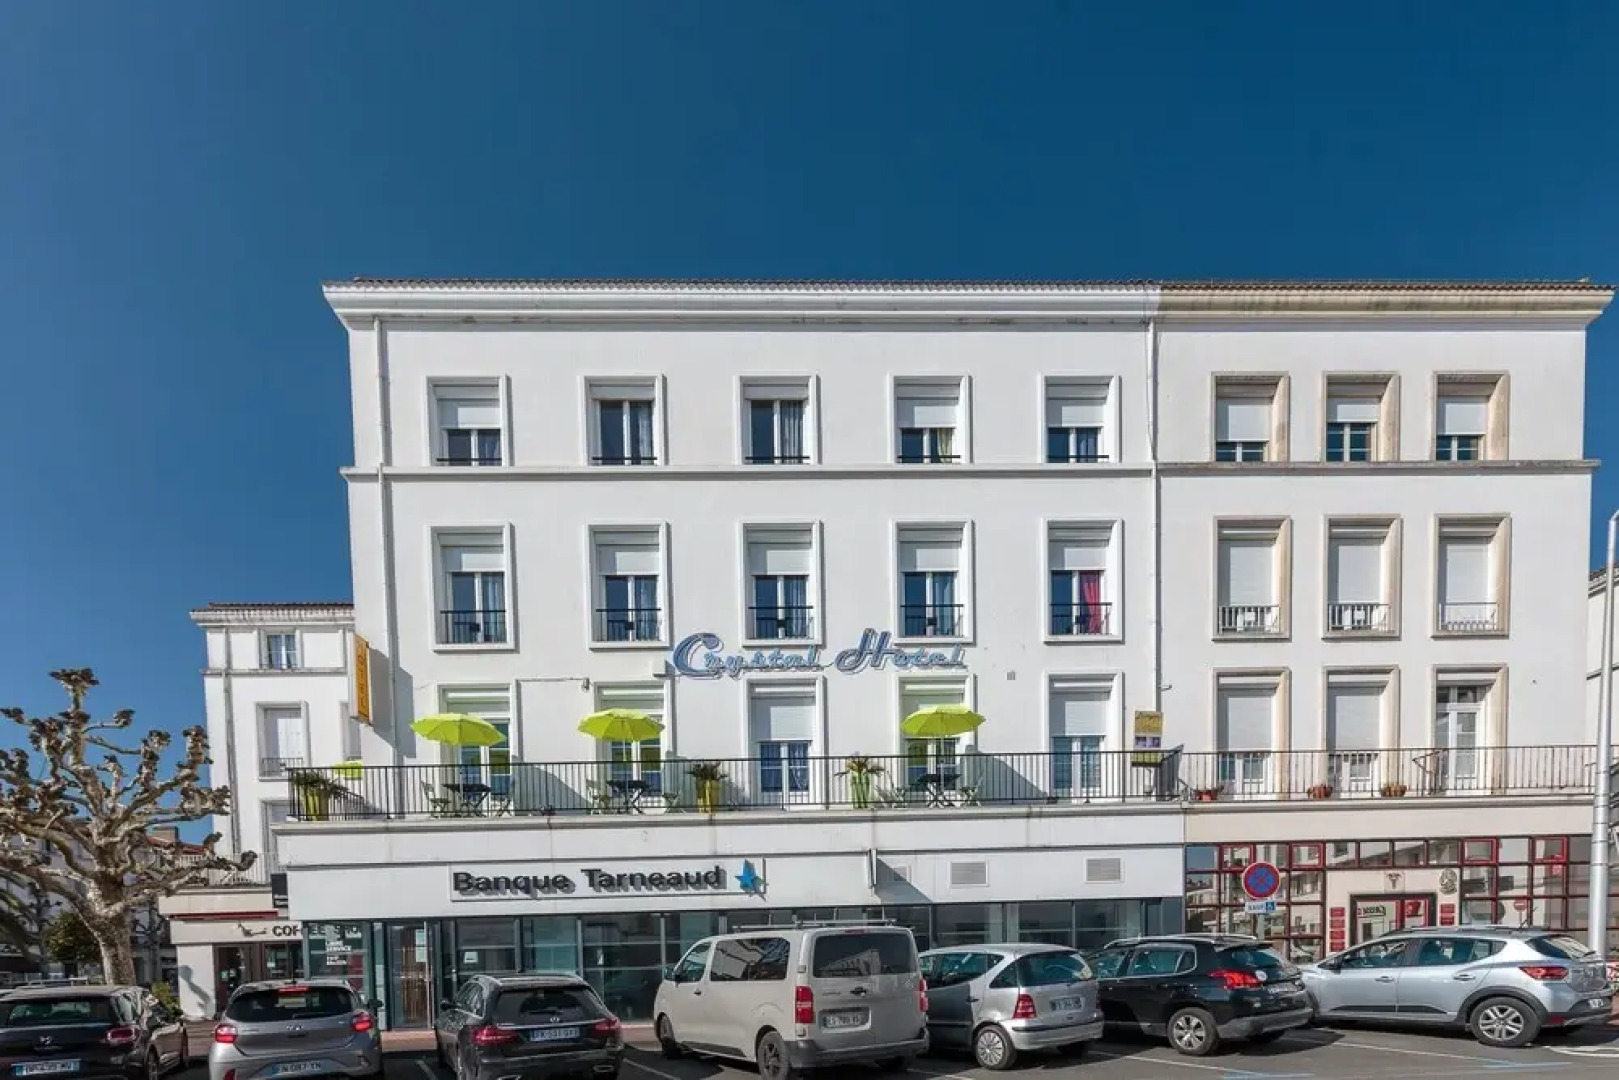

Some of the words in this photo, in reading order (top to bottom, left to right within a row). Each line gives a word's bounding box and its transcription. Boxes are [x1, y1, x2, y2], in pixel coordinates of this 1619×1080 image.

[673, 632, 822, 678] Crystal
[452, 871, 570, 897] Banque
[581, 865, 722, 889] Tarneaud
